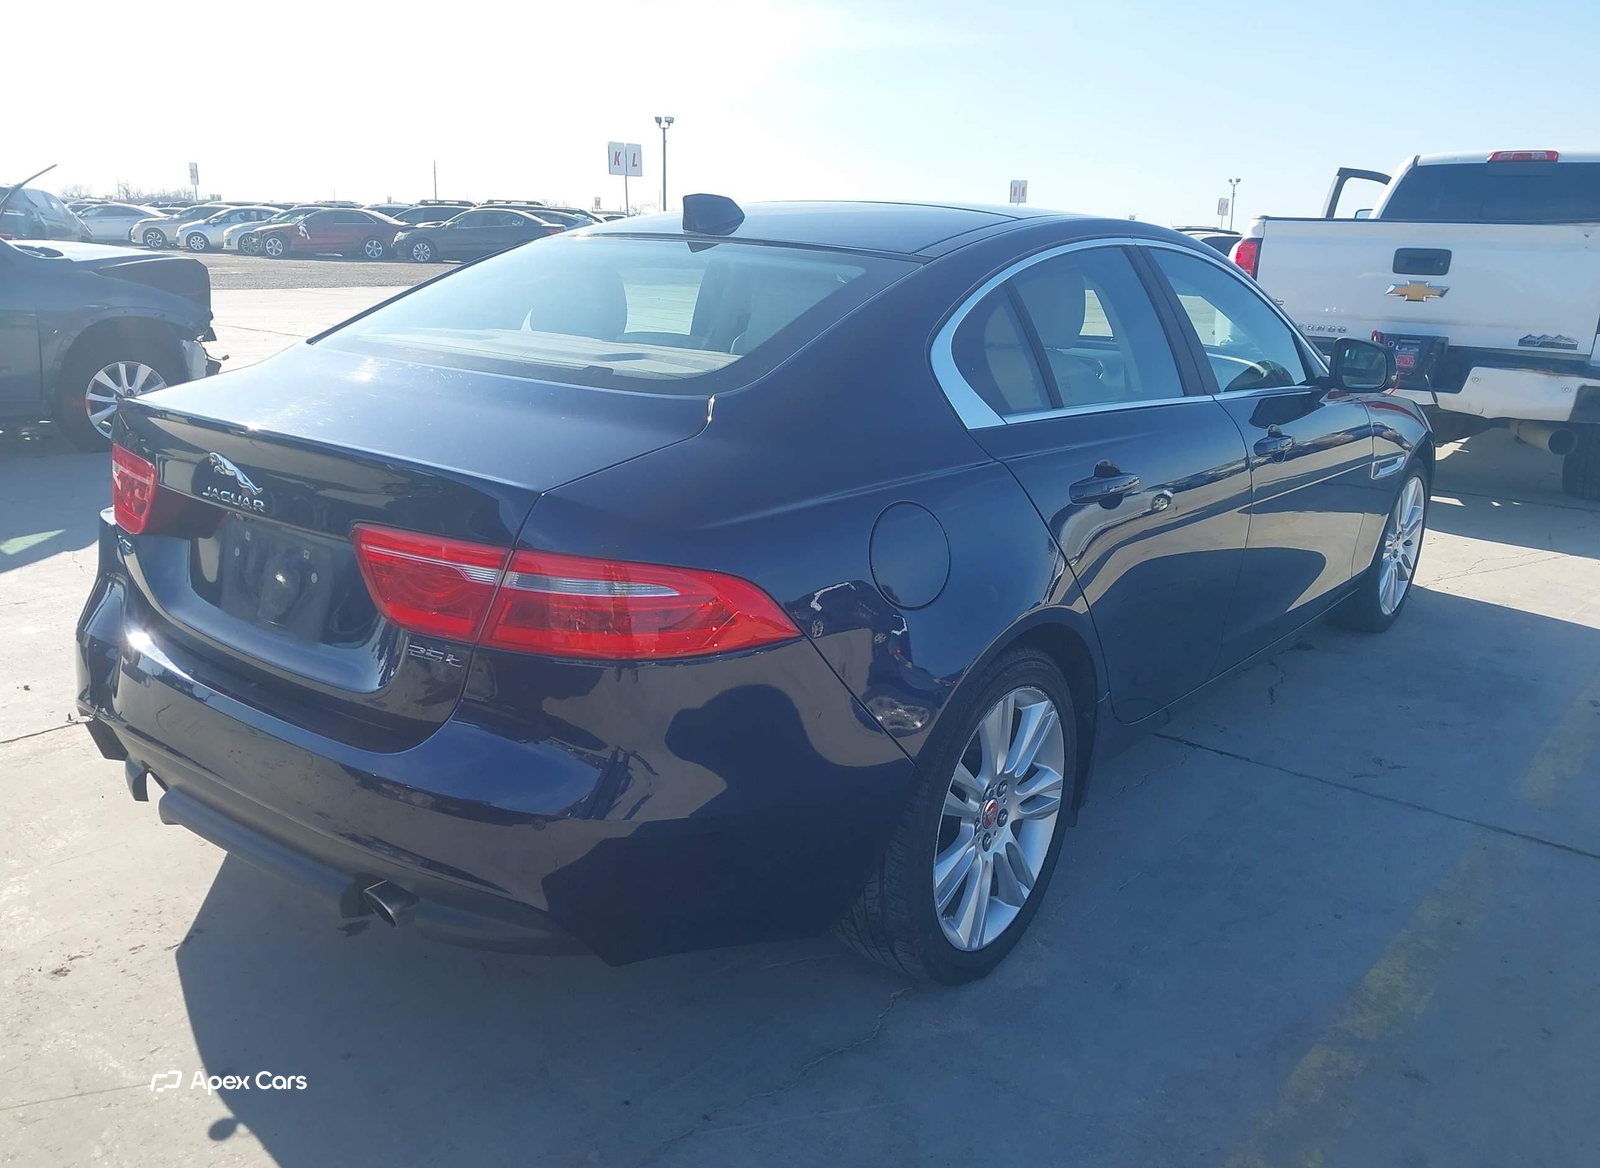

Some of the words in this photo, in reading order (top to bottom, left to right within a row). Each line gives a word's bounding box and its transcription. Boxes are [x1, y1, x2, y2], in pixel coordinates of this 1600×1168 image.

[613, 151, 621, 166] K
[631, 152, 638, 168] L
[202, 486, 265, 513] JAGUAR
